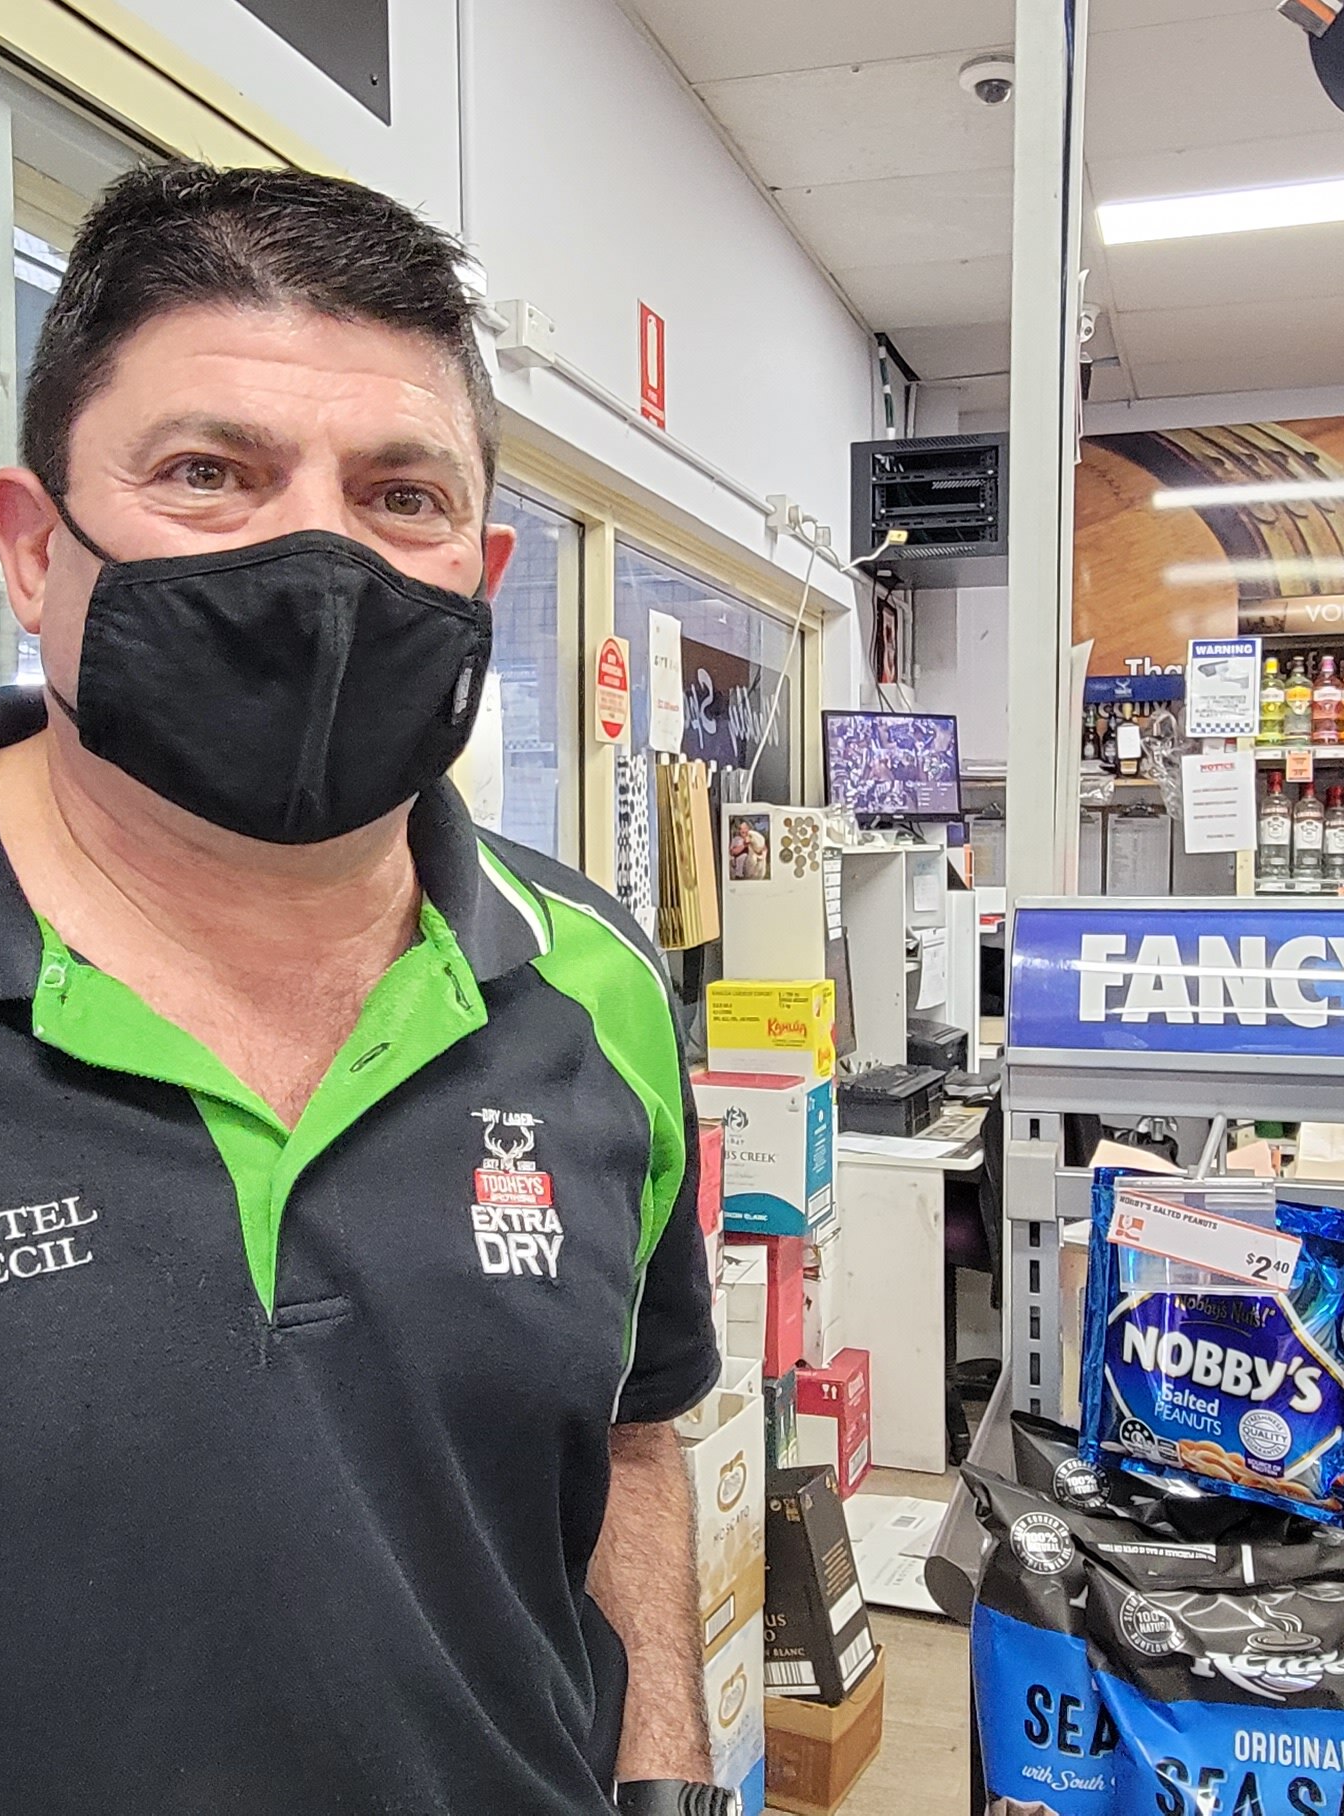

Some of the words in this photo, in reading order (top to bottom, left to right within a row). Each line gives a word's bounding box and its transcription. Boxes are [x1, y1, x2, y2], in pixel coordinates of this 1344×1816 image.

[1194, 643, 1254, 657] WARNING
[481, 1108, 501, 1124] DRY
[739, 1151, 776, 1164] CREEK
[480, 1174, 545, 1197] TOOHEYS
[470, 1203, 565, 1234] EXTRA
[1152, 1204, 1182, 1220] SALTED
[1182, 1213, 1219, 1231] PEANUTS
[473, 1231, 566, 1280] DRY
[1122, 1320, 1324, 1414] NOBBY'S
[1160, 1382, 1220, 1418] Salted
[1154, 1402, 1223, 1437] PEANUTS
[1243, 1414, 1284, 1432] FRESHNESS
[1241, 1425, 1289, 1444] QUALITY
[1066, 1474, 1098, 1488] 100%
[1024, 1531, 1059, 1544] 100%
[1136, 1610, 1166, 1623] 100
[1139, 1620, 1174, 1634] NATURA
[1024, 1683, 1122, 1758] SEA
[1021, 1764, 1055, 1786] with
[1051, 1769, 1106, 1791] South
[1156, 1755, 1265, 1816] SEA
